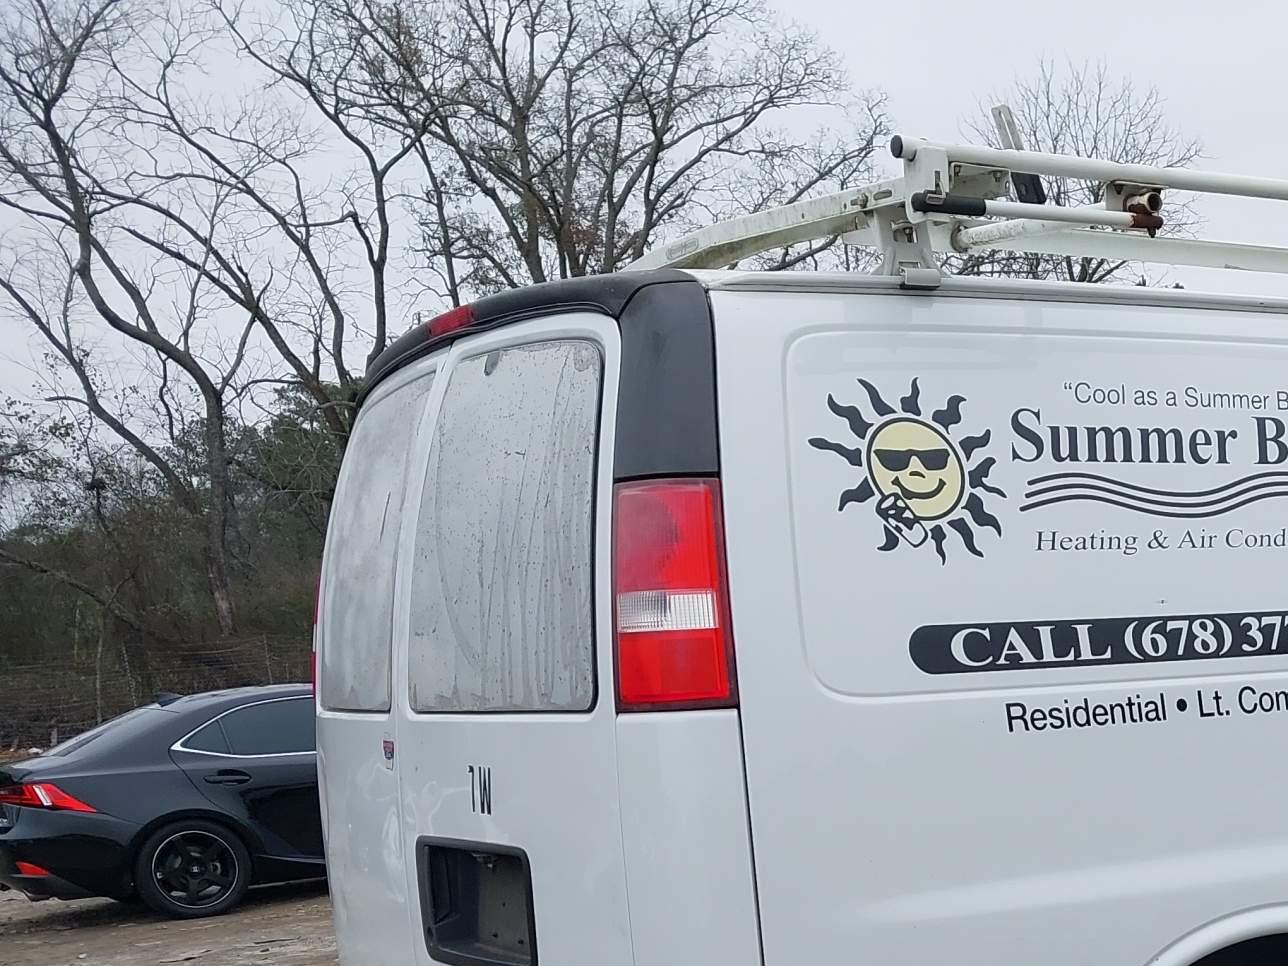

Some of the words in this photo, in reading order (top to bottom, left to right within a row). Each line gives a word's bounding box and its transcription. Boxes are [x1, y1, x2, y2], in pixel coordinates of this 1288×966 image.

[1063, 381, 1125, 404] “Cool
[1133, 389, 1158, 406] as
[1165, 391, 1177, 406] a
[1184, 386, 1270, 410] Summer
[1010, 407, 1238, 464] Summer
[1035, 529, 1138, 556] Heating
[1147, 529, 1169, 549] &
[1177, 528, 1218, 549] Air
[950, 624, 1112, 667] CALL
[1124, 617, 1233, 660] (678)
[1005, 692, 1168, 733] Residential
[1197, 690, 1231, 718] Lt.
